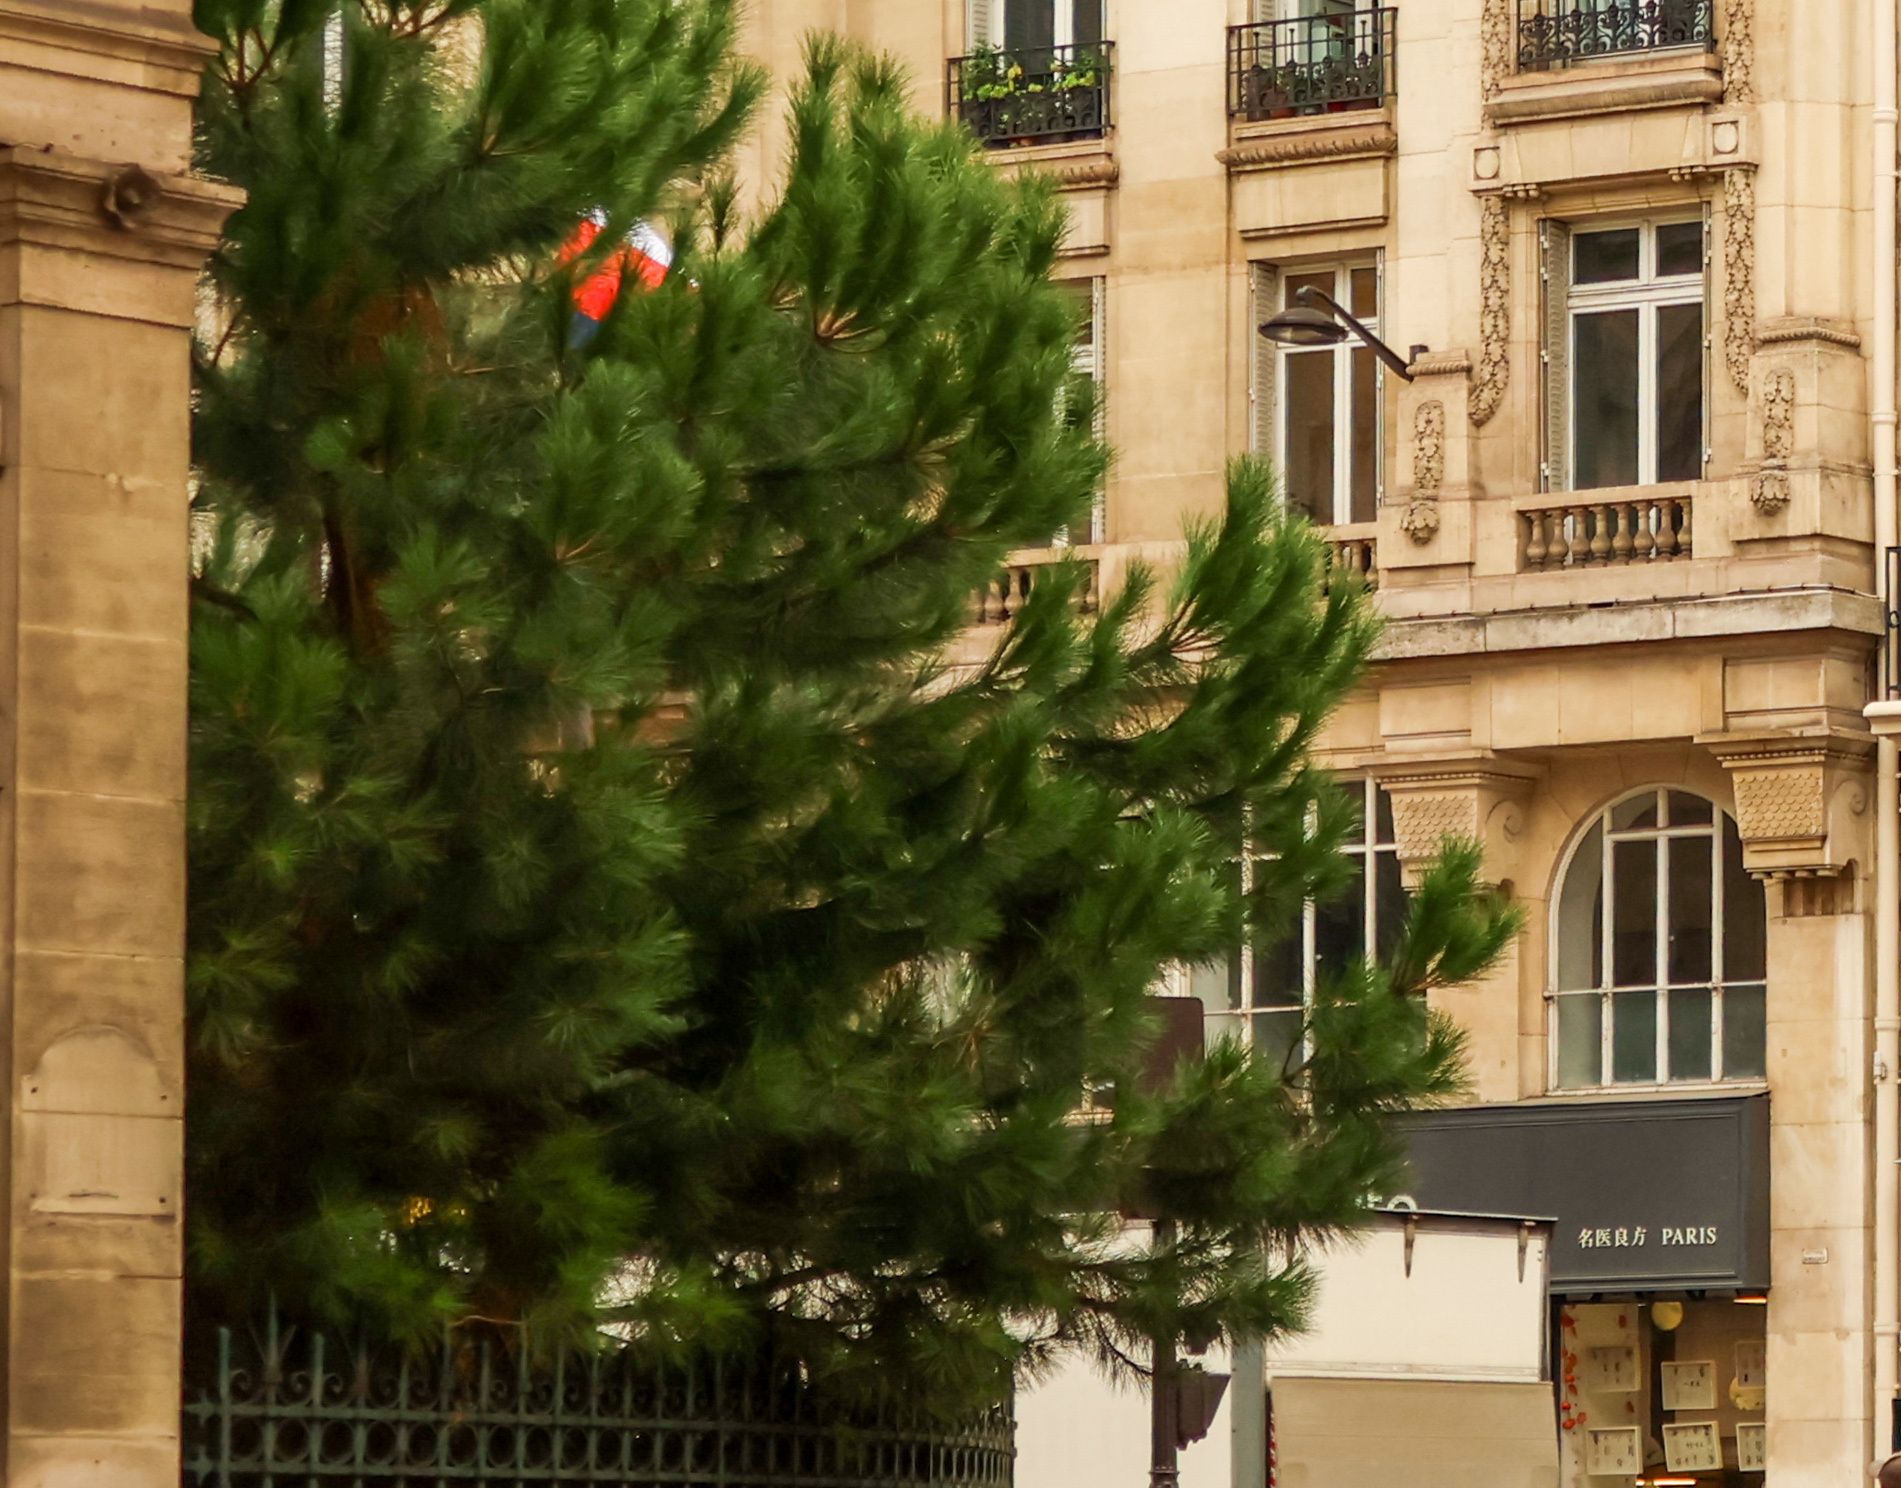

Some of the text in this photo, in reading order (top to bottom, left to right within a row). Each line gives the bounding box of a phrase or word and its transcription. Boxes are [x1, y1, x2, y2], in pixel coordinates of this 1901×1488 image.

[1578, 1226, 1718, 1249] 名医良方 PARIS
